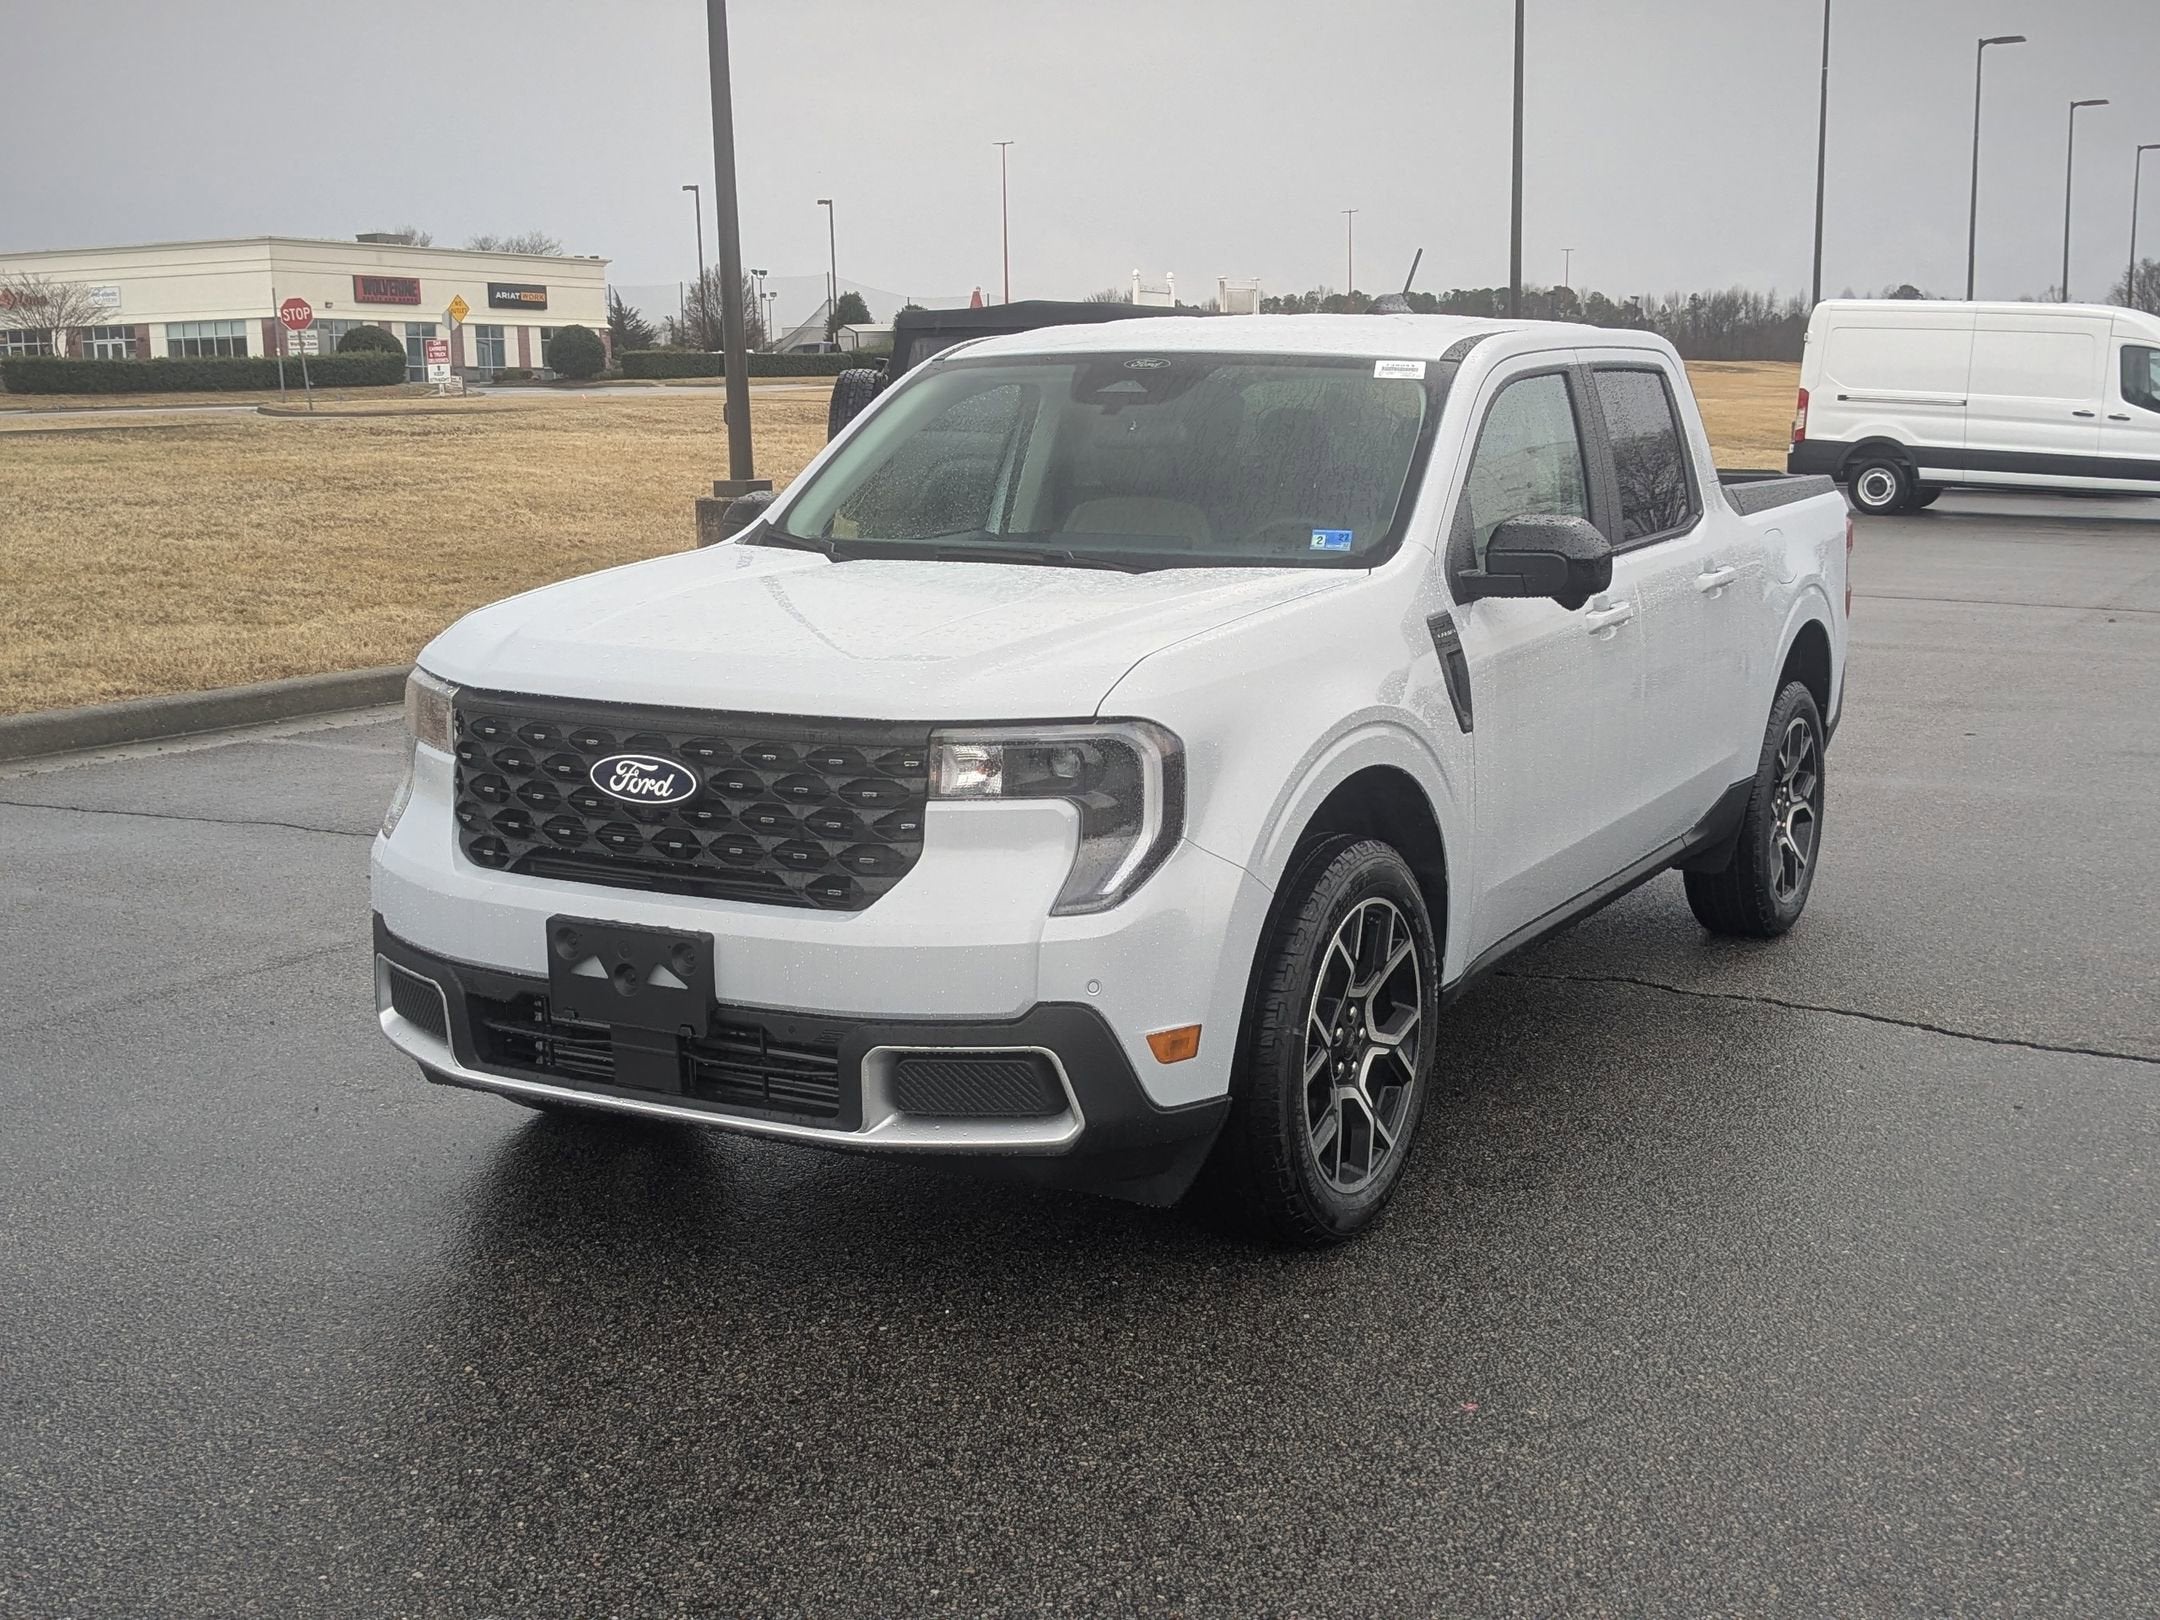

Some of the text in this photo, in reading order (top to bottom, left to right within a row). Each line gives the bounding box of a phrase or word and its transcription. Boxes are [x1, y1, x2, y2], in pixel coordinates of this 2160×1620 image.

[362, 278, 417, 297] WOLVERINE
[495, 291, 545, 301] ARIAT WORK
[282, 307, 310, 321] STOP
[1316, 535, 1324, 545] 2
[1338, 533, 1350, 542] 27
[609, 760, 676, 797] Ford
